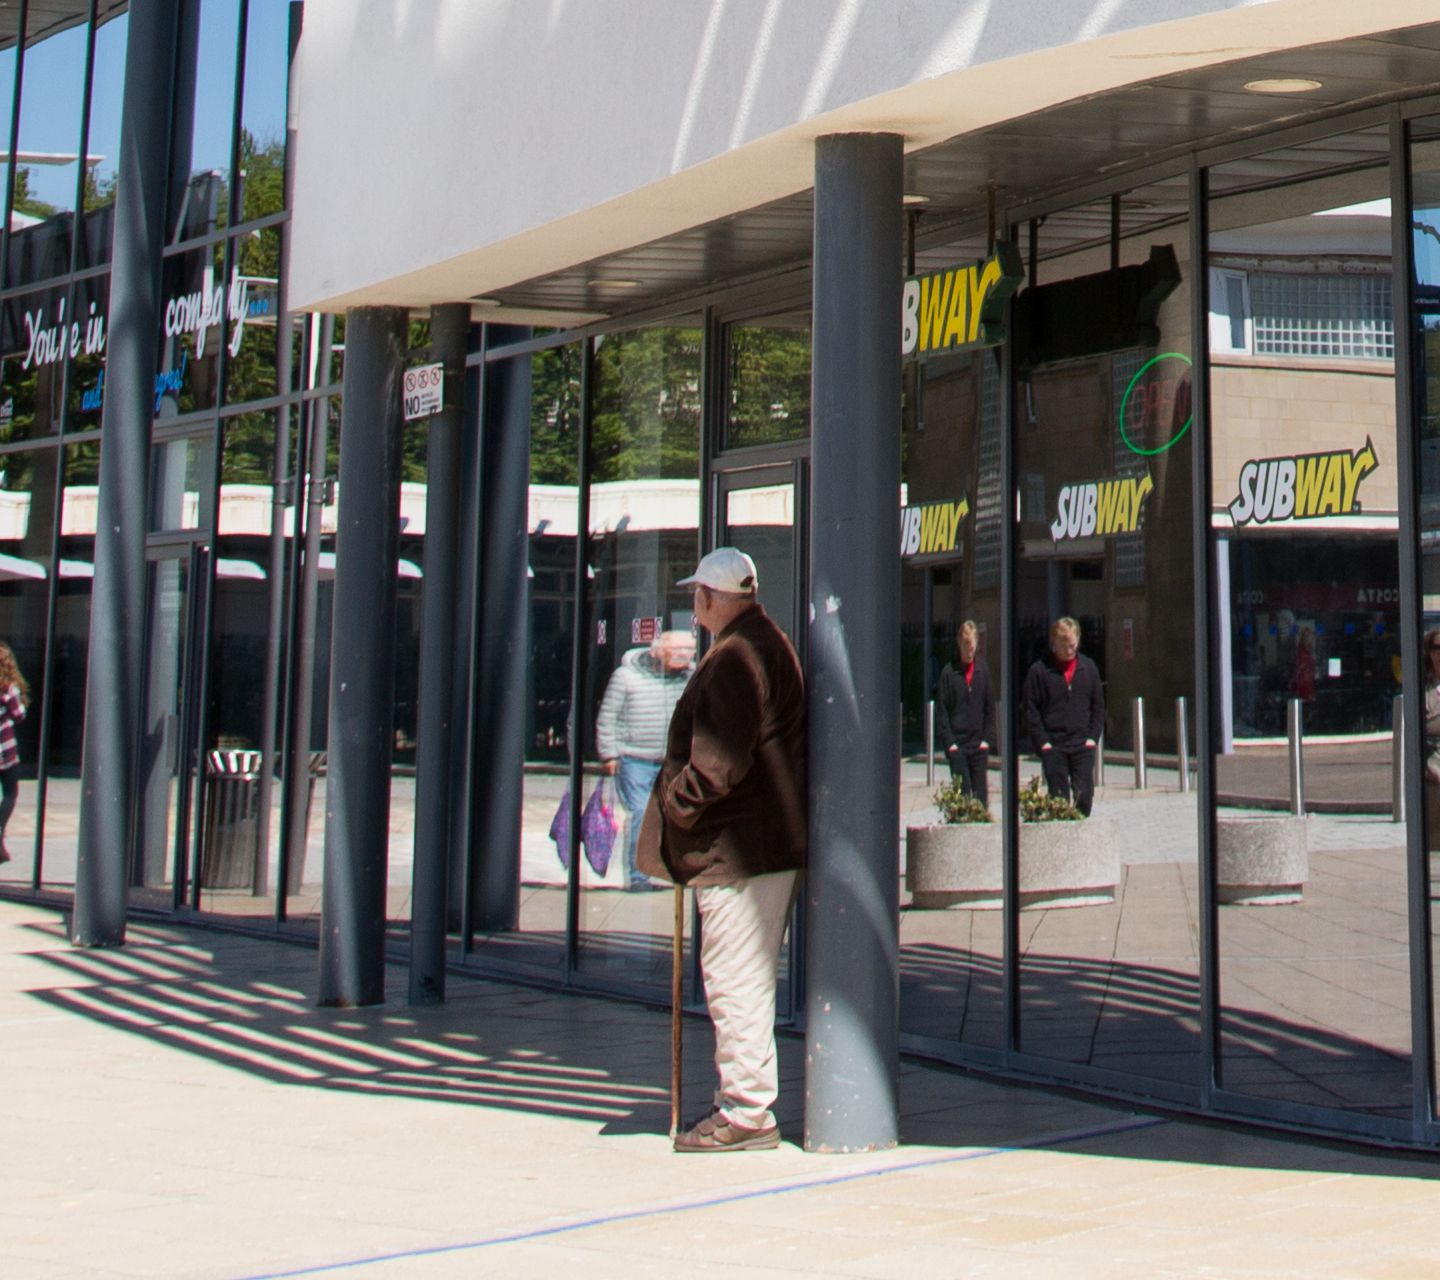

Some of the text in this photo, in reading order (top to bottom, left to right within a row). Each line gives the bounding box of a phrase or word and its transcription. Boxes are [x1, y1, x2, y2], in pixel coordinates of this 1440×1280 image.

[85, 301, 105, 356] in
[902, 258, 1002, 355] BWAY
[406, 395, 420, 416] NO
[1050, 474, 1153, 543] SUBWAY
[1231, 446, 1379, 527] SUBWAY
